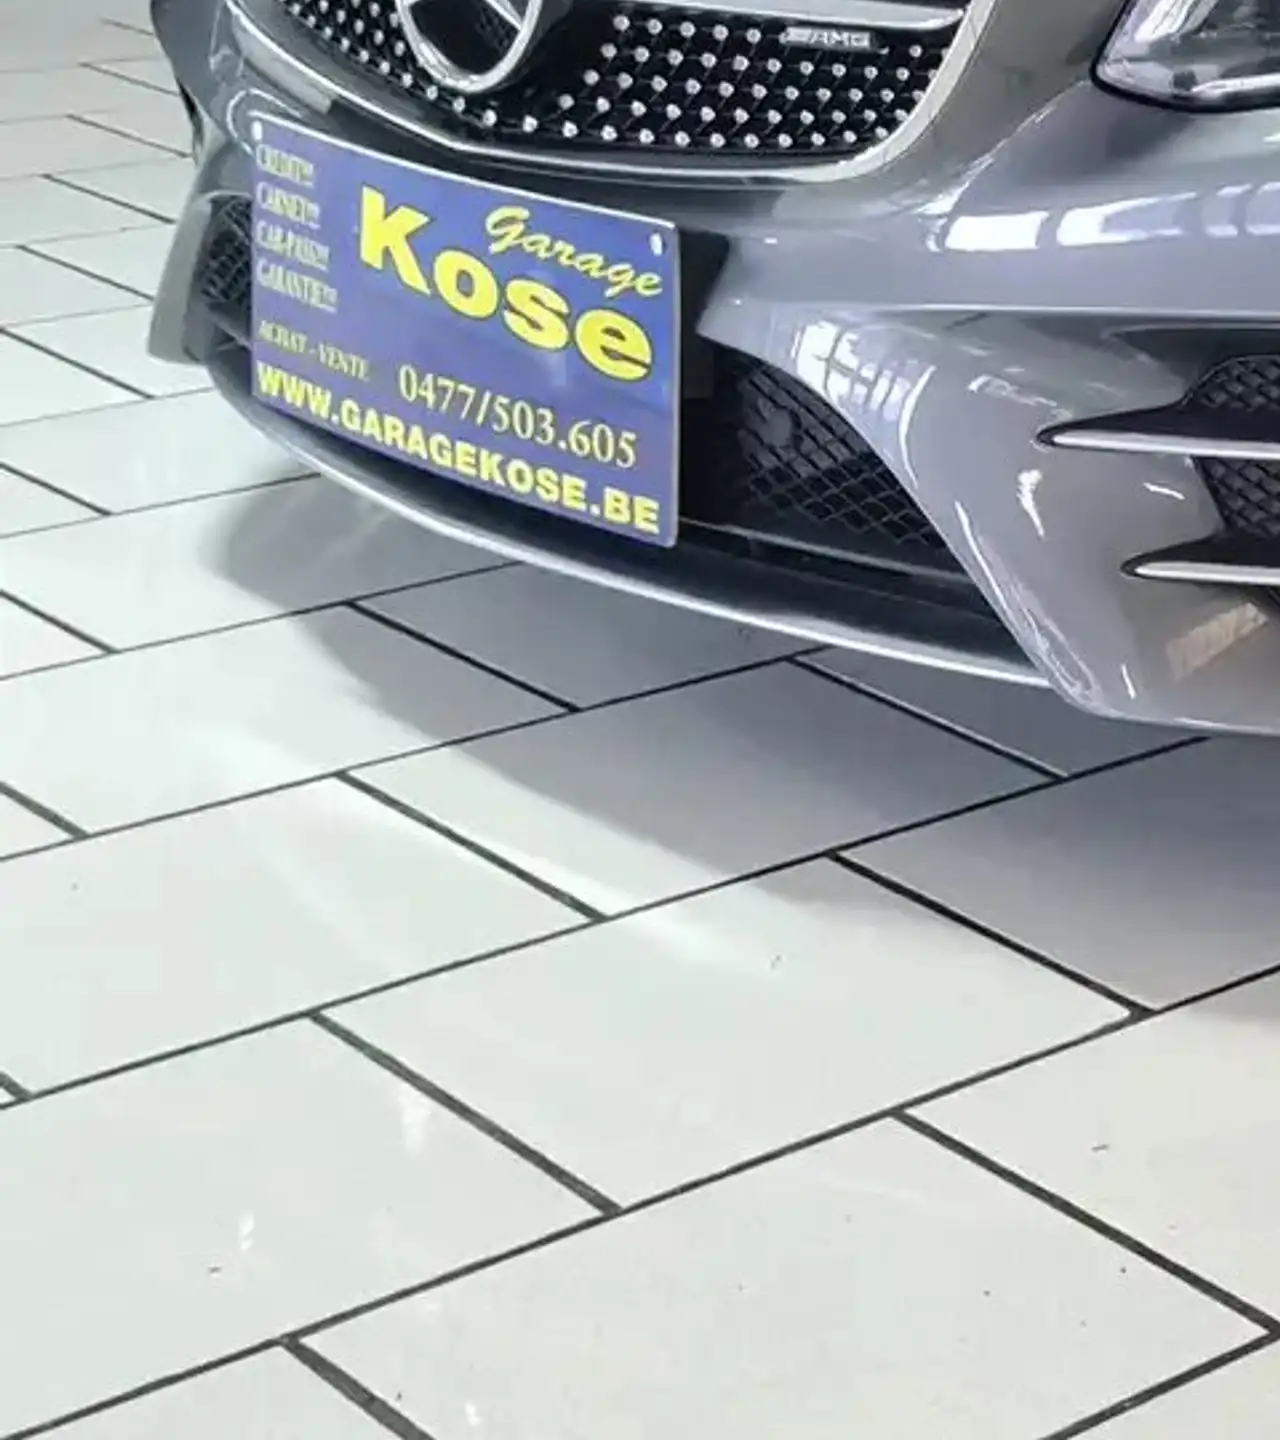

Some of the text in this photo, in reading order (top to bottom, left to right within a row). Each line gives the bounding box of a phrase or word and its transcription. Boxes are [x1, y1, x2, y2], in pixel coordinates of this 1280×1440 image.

[358, 184, 654, 381] Kose
[485, 205, 663, 298] Garage
[256, 360, 661, 536] WWW.GARAGEKOSE.BE
[400, 364, 638, 469] 0477/503.605
